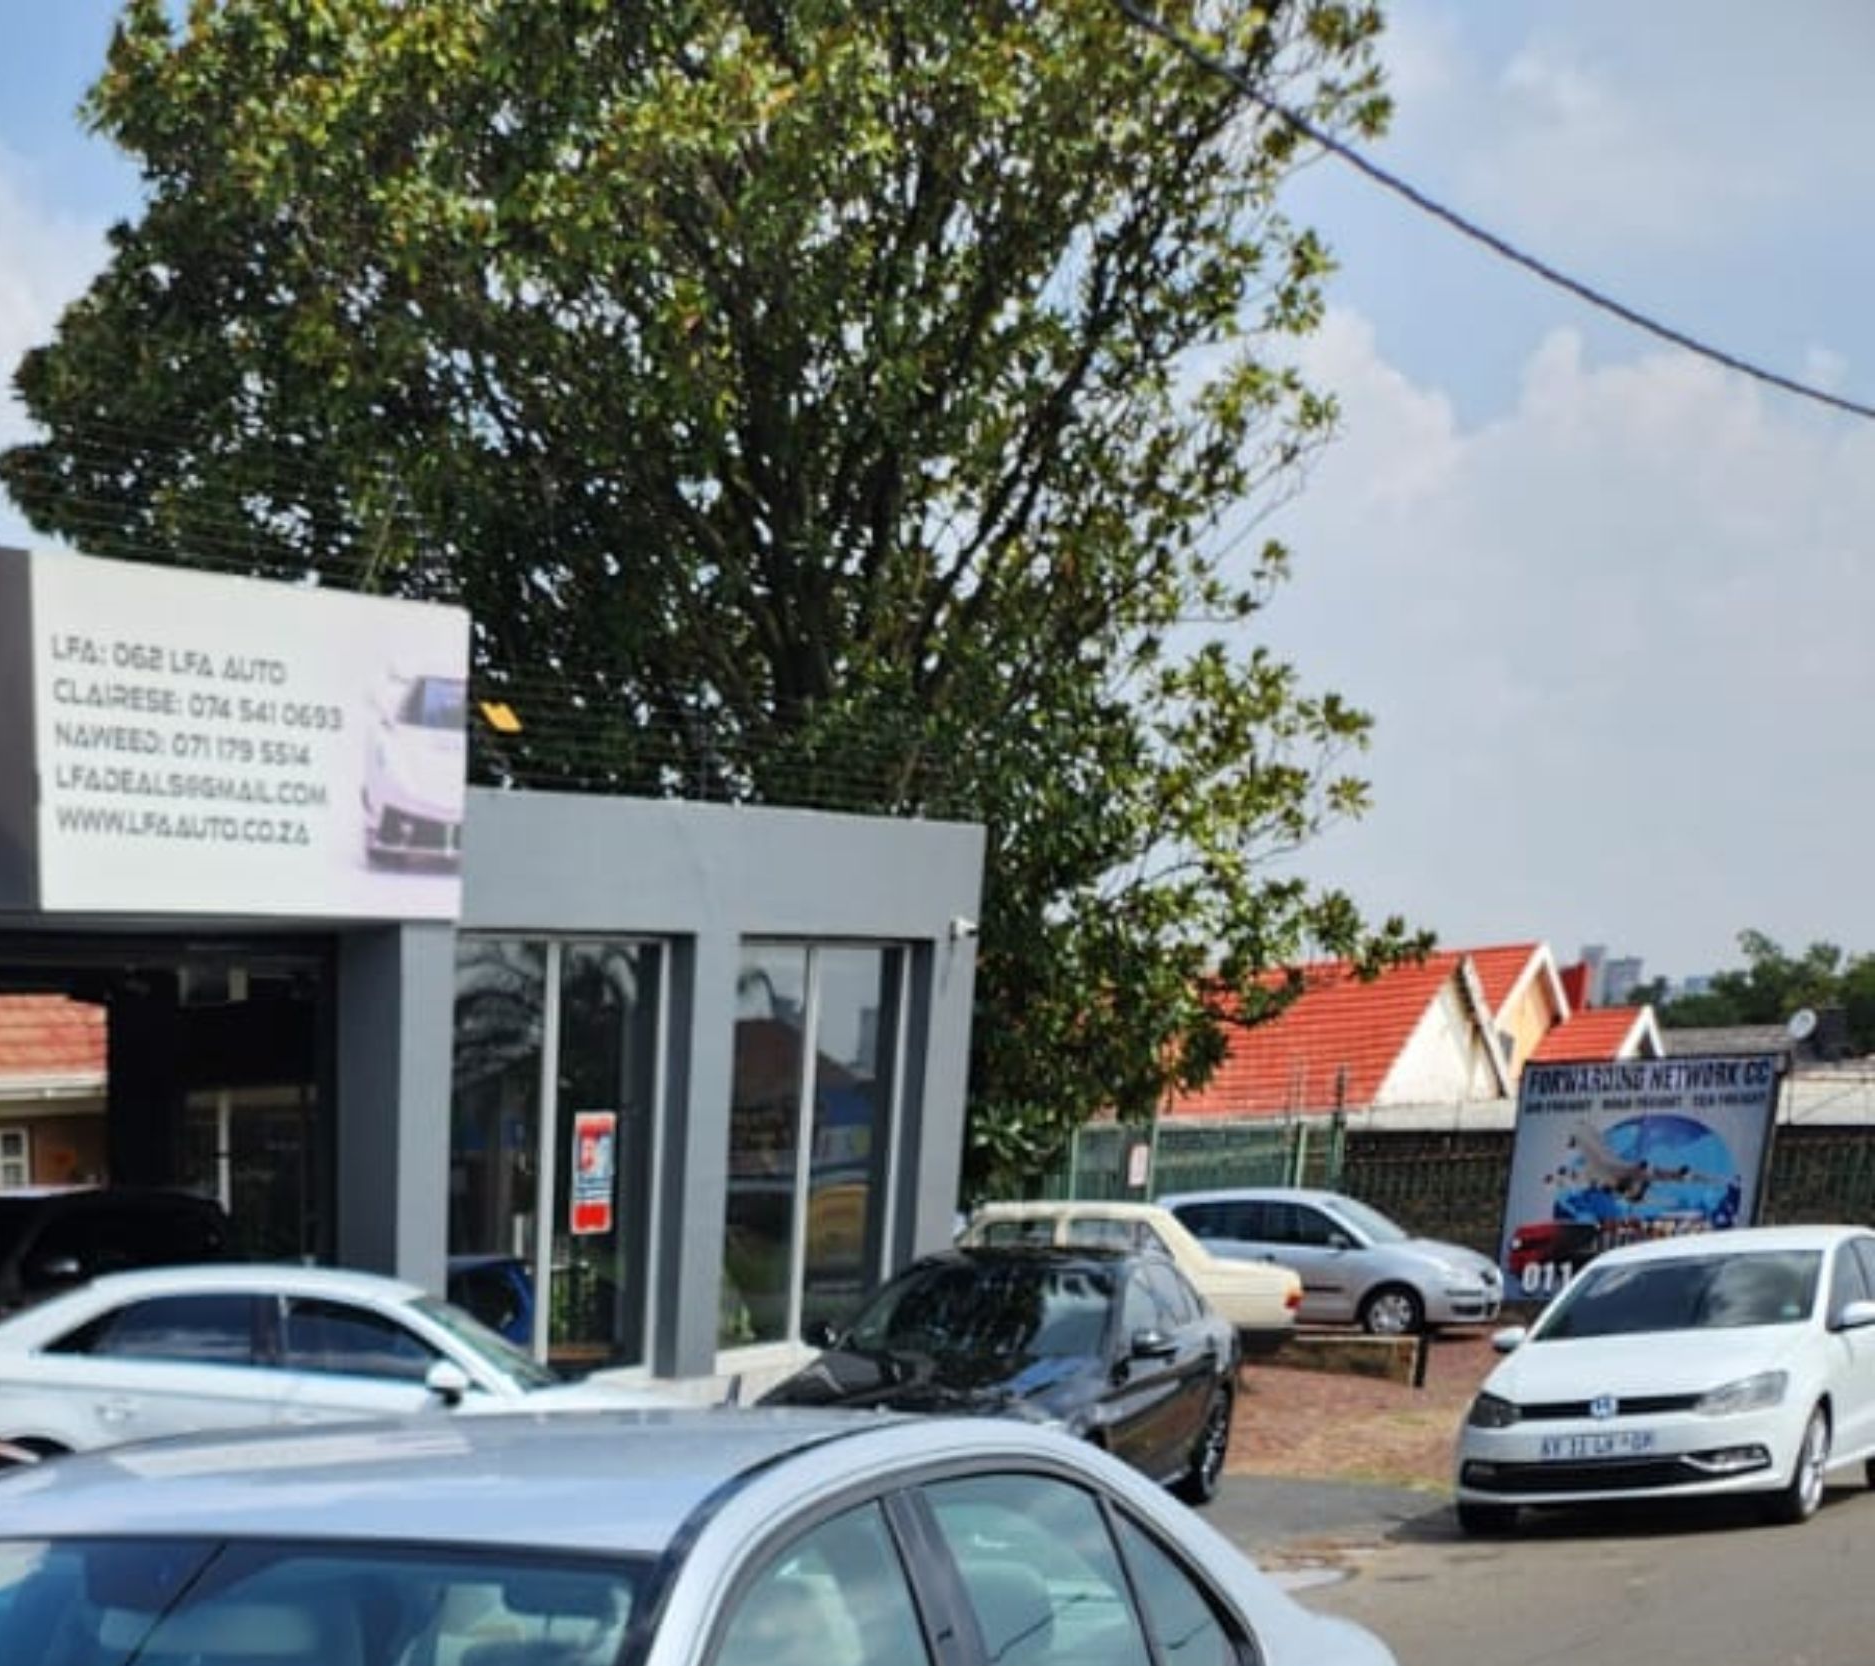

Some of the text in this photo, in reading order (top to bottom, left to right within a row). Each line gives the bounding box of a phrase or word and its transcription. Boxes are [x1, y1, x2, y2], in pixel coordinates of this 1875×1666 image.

[51, 635, 287, 685] LFA: 062 LFA AUTO
[187, 692, 232, 720] 074
